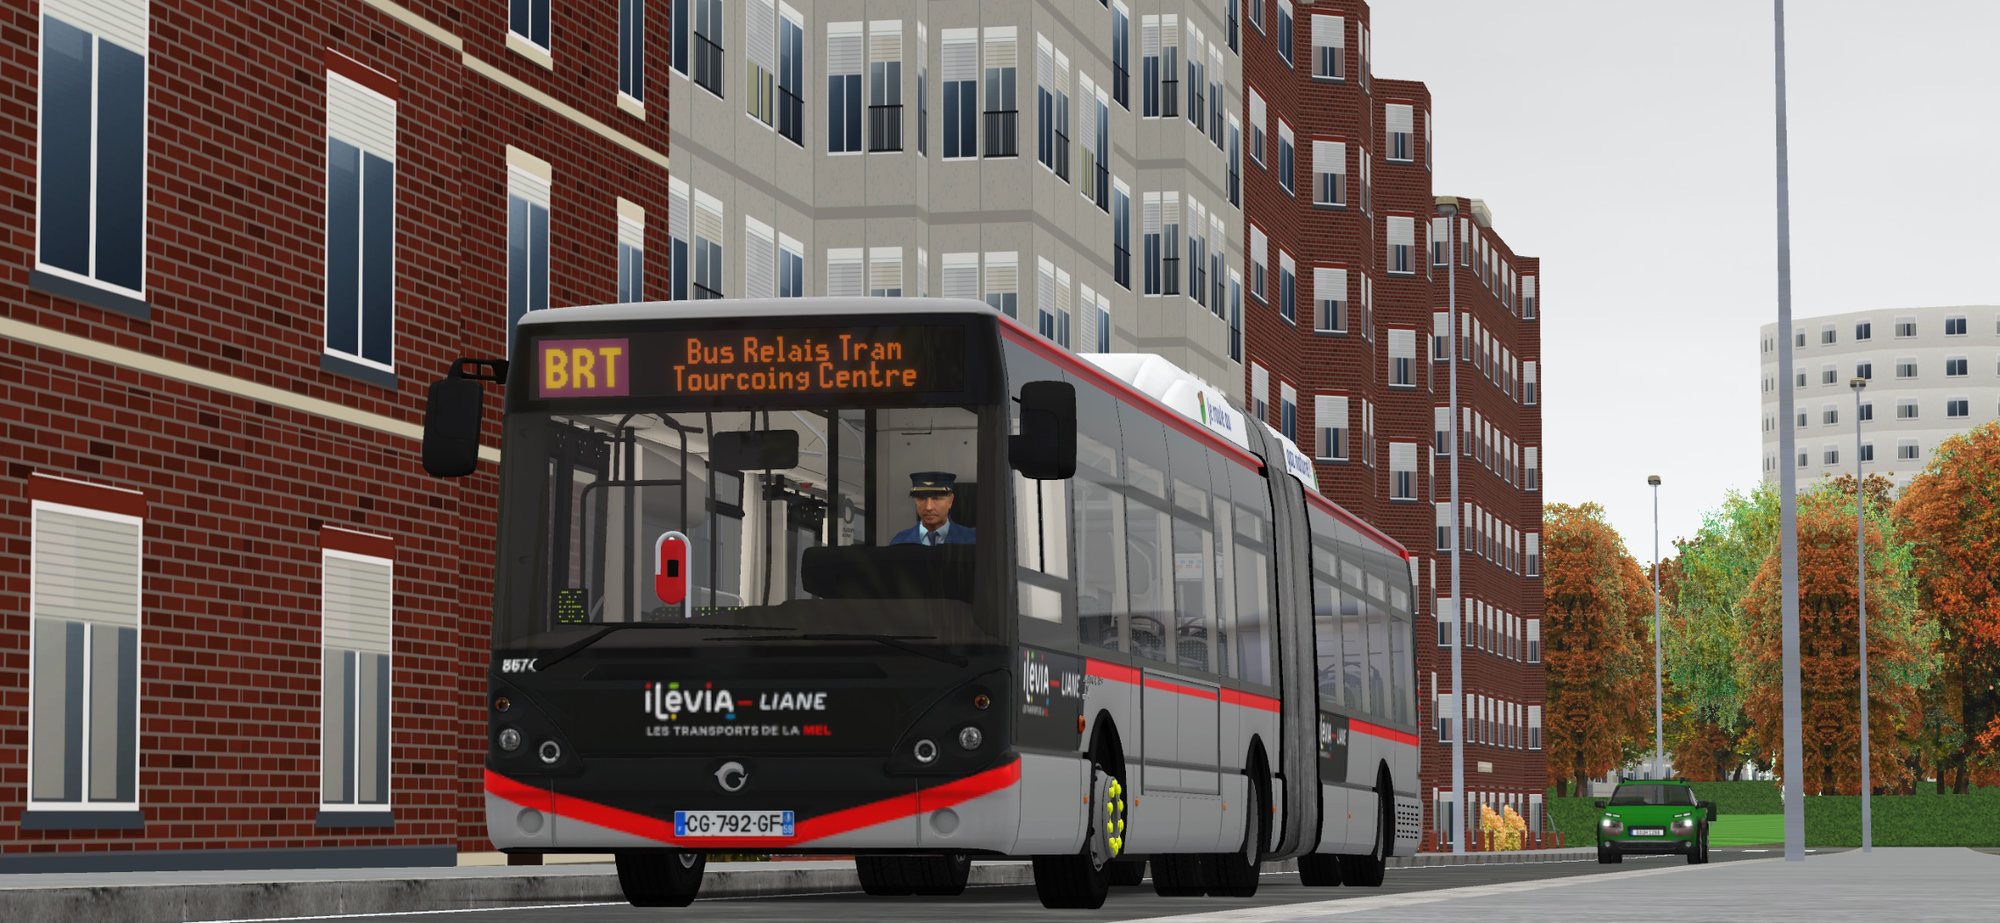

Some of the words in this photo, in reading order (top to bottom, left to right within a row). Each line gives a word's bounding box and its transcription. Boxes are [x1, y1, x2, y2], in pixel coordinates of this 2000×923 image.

[687, 338, 734, 365] Bus
[743, 335, 828, 363] Relais
[838, 335, 902, 362] Tram
[544, 345, 622, 390] BRT
[673, 364, 811, 392] Tourcoing
[819, 363, 917, 389] Centre
[1061, 671, 1081, 699] LIANE
[758, 691, 828, 712] LIANE
[646, 725, 670, 737] LES
[672, 725, 759, 737] TRANSPORTS
[761, 725, 779, 736] DE
[782, 725, 800, 736] LA
[802, 724, 832, 736] MEL
